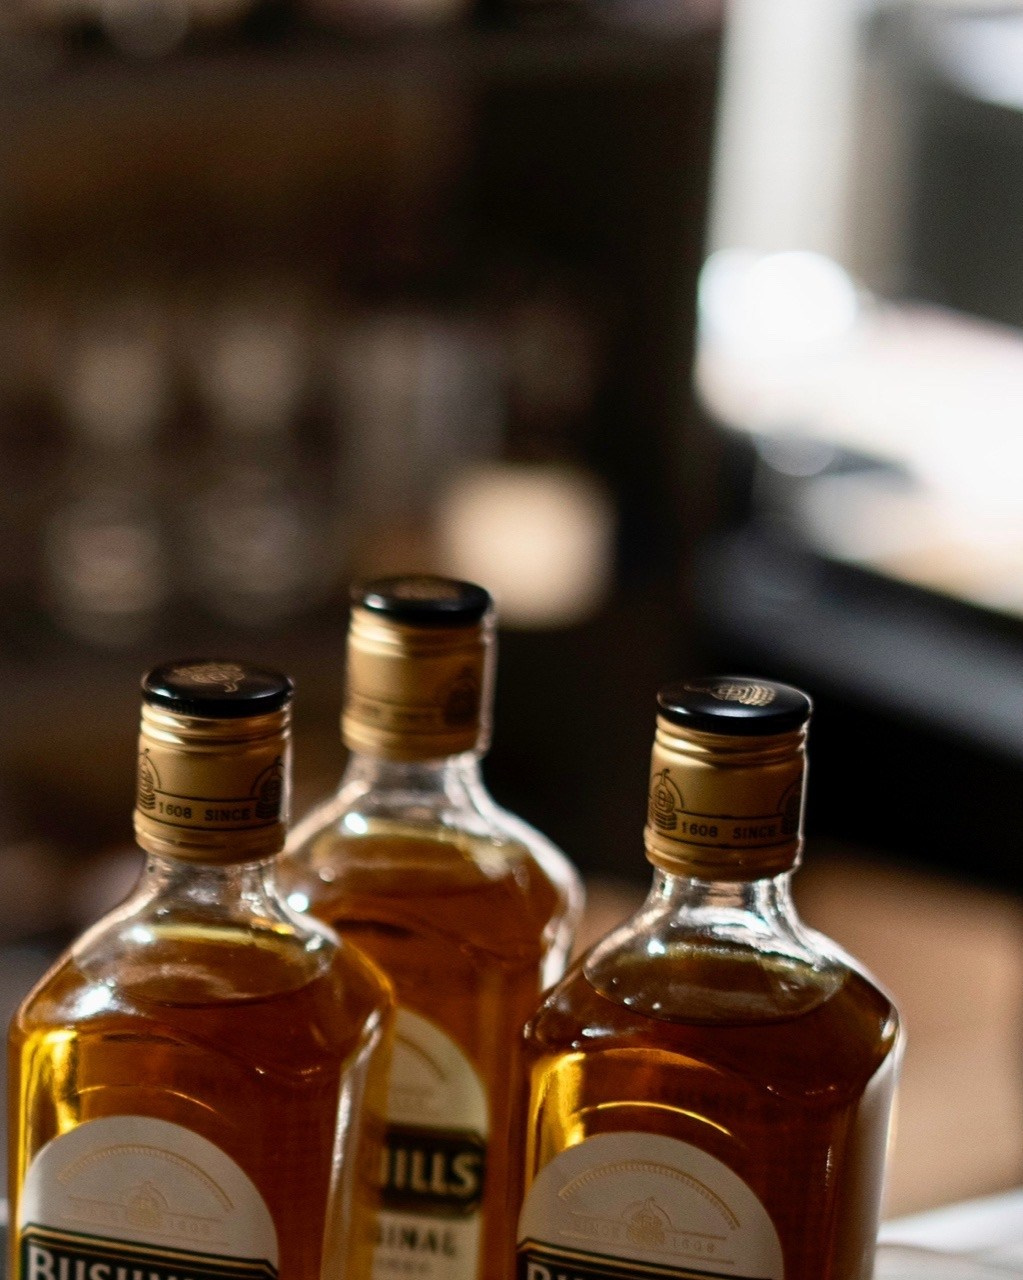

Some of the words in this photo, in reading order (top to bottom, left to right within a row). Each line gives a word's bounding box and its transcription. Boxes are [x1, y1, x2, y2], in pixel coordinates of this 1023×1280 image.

[158, 801, 192, 819] 1608
[204, 808, 251, 822] SINCE
[681, 821, 718, 838] 1608
[732, 825, 777, 840] SINCE
